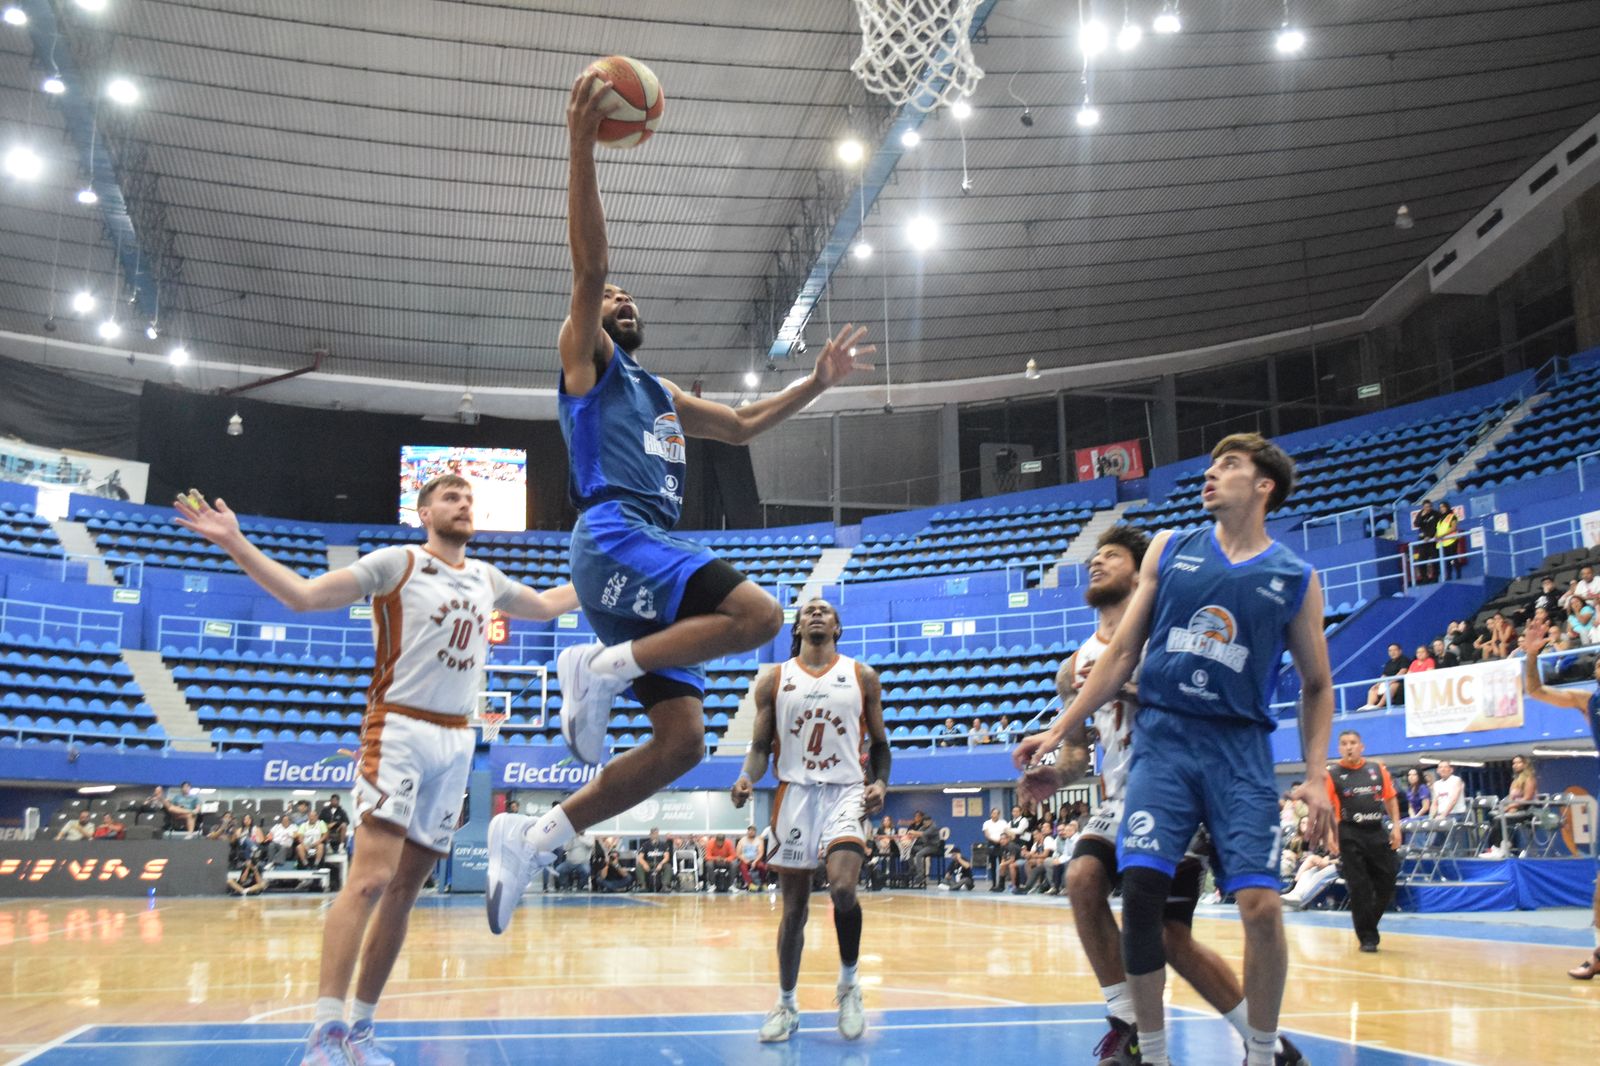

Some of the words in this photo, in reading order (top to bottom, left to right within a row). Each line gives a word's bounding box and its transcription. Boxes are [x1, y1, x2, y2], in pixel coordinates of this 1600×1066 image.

[448, 618, 473, 651] 10
[1409, 675, 1474, 711] VMC
[807, 722, 825, 756] 4
